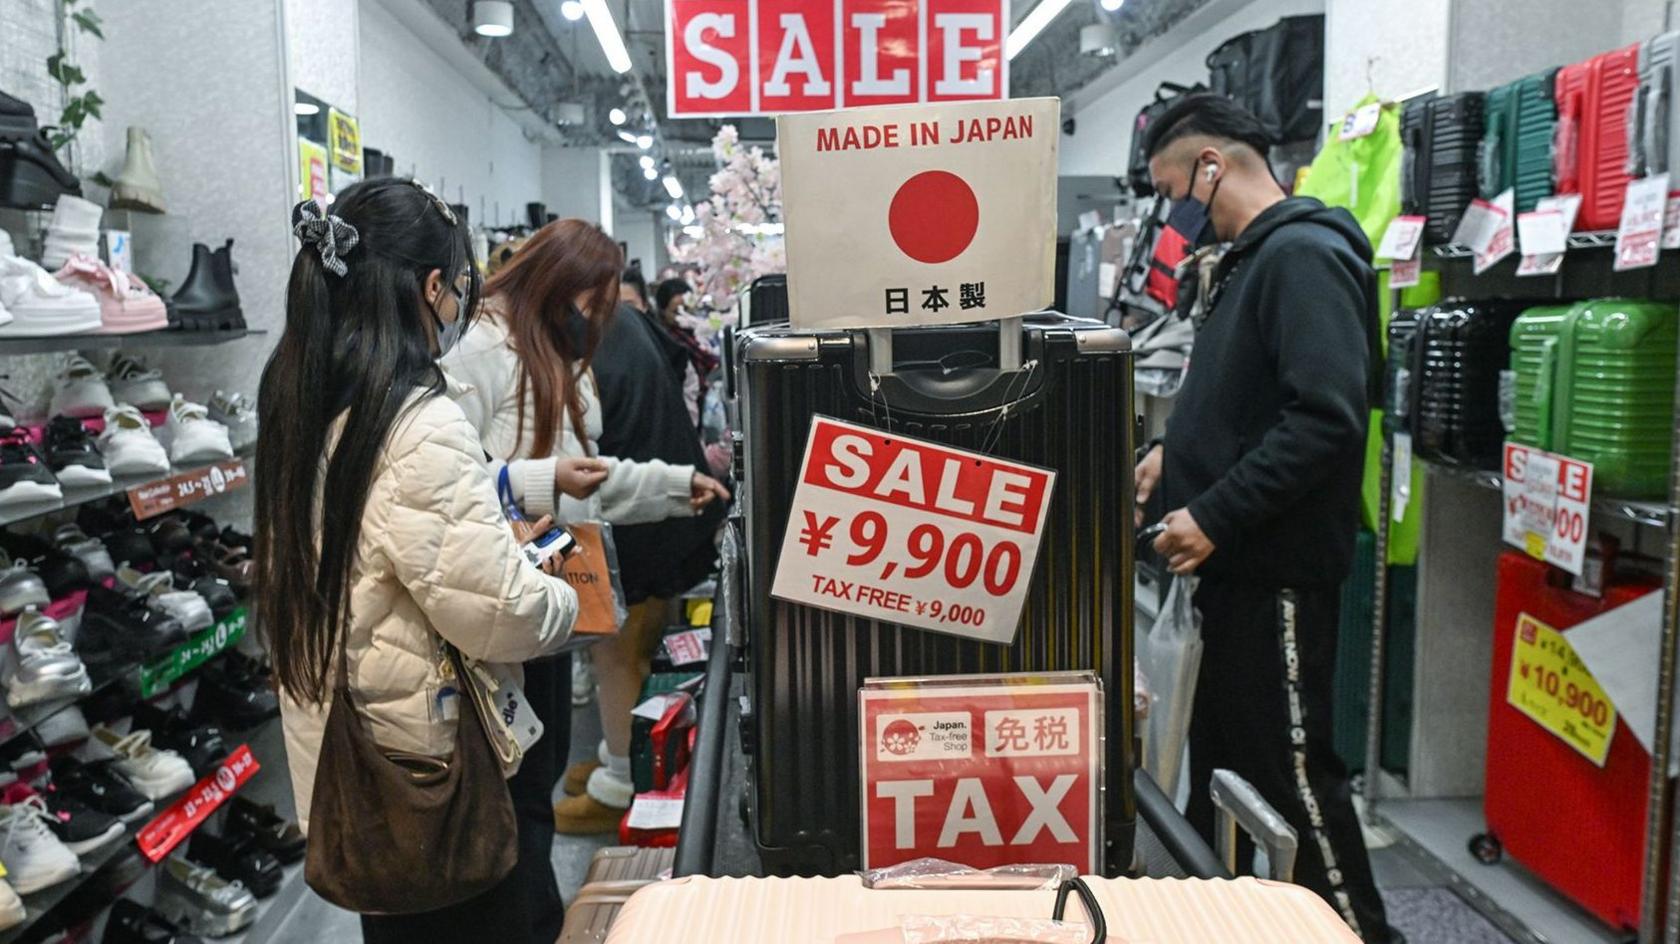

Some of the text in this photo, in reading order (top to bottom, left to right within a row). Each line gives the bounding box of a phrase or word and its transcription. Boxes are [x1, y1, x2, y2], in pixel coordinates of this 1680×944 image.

[684, 12, 994, 99] SALE
[816, 115, 1033, 152] MADE IN JAPAN
[885, 282, 986, 314] 日本製
[824, 434, 1032, 526] SALE
[799, 510, 1021, 596] ¥9,900
[812, 575, 985, 627] TAX FREE ¥9,000
[930, 732, 967, 742] Tax-free
[933, 720, 967, 731] Japan.
[995, 715, 1069, 752] 免税
[944, 742, 968, 752] Shop
[876, 774, 1080, 849] TAX
